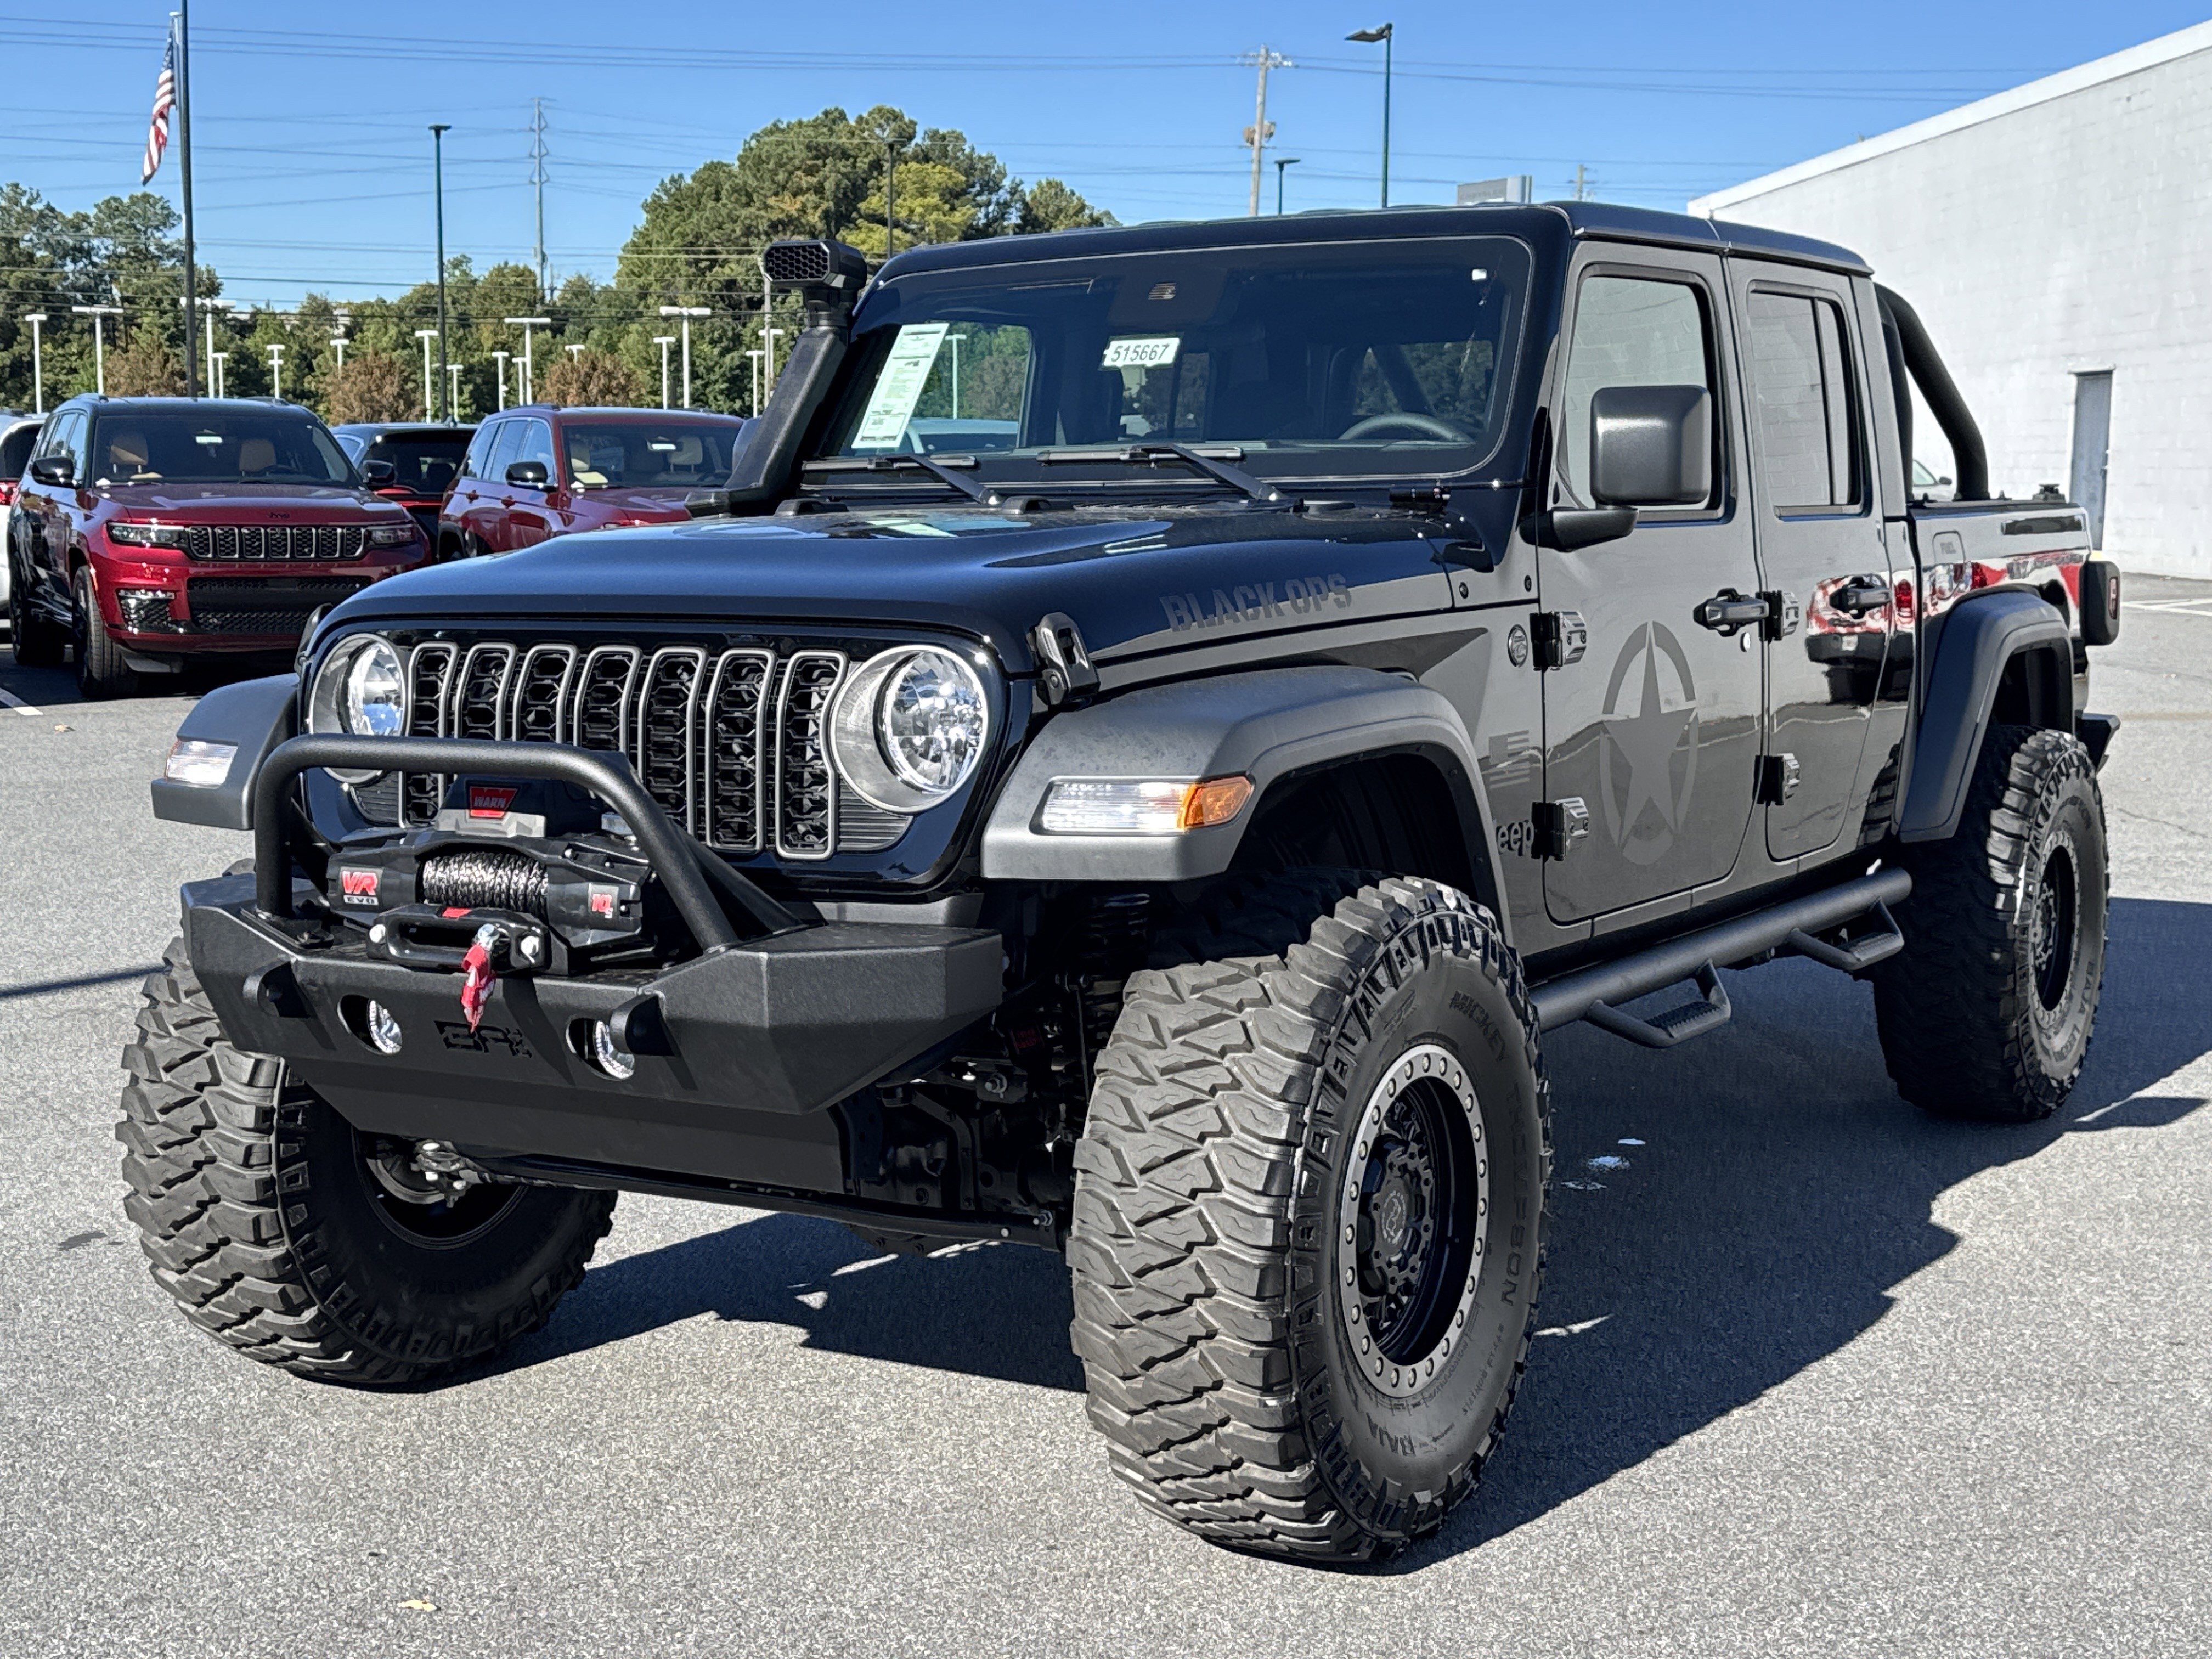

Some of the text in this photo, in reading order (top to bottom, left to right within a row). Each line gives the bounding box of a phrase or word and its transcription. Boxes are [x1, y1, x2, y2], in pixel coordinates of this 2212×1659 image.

[1111, 343, 1170, 362] 515667
[1159, 573, 1352, 633] BLACK OPS
[473, 796, 506, 809] WARN
[1492, 818, 1535, 856] eep
[342, 870, 379, 896] VR
[1449, 990, 1506, 1063] MICKEY
[1365, 1412, 1417, 1457] BAJA
